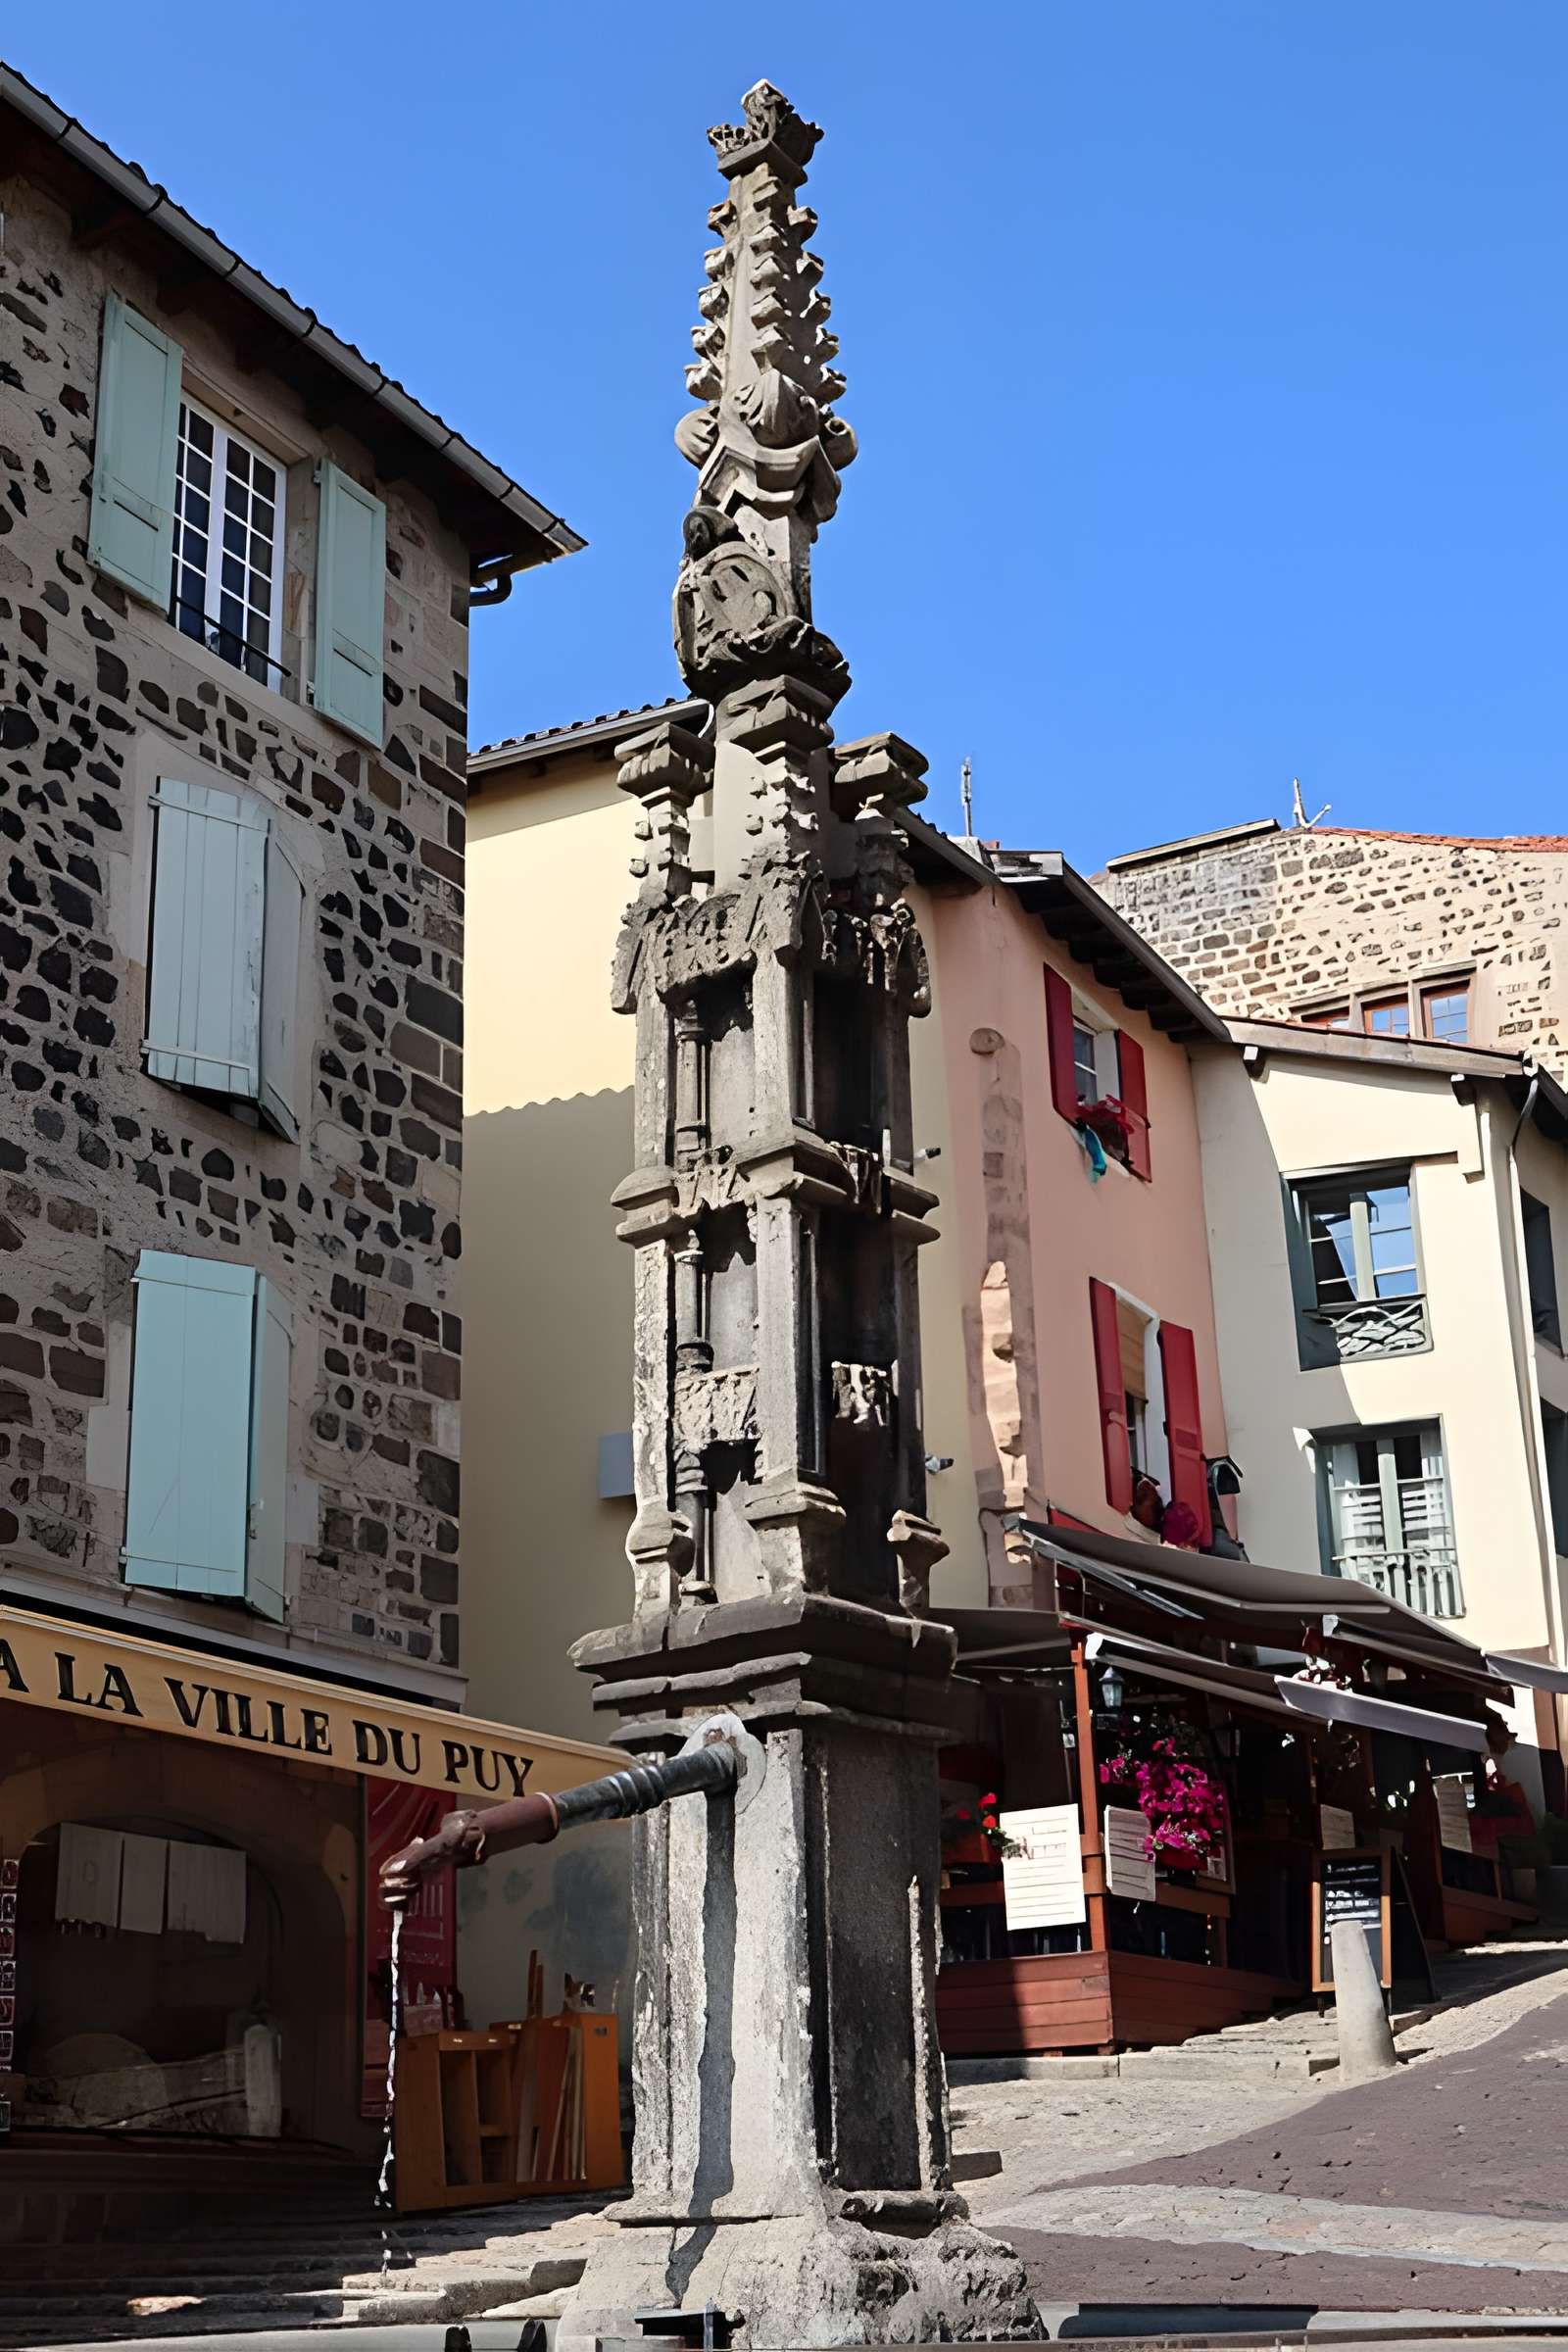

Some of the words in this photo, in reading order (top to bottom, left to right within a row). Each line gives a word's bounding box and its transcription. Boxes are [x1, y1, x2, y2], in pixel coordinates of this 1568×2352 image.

[54, 1651, 144, 1717] LA
[164, 1677, 332, 1755] VILLE
[352, 1720, 421, 1775] DU
[441, 1740, 534, 1797] PUY
